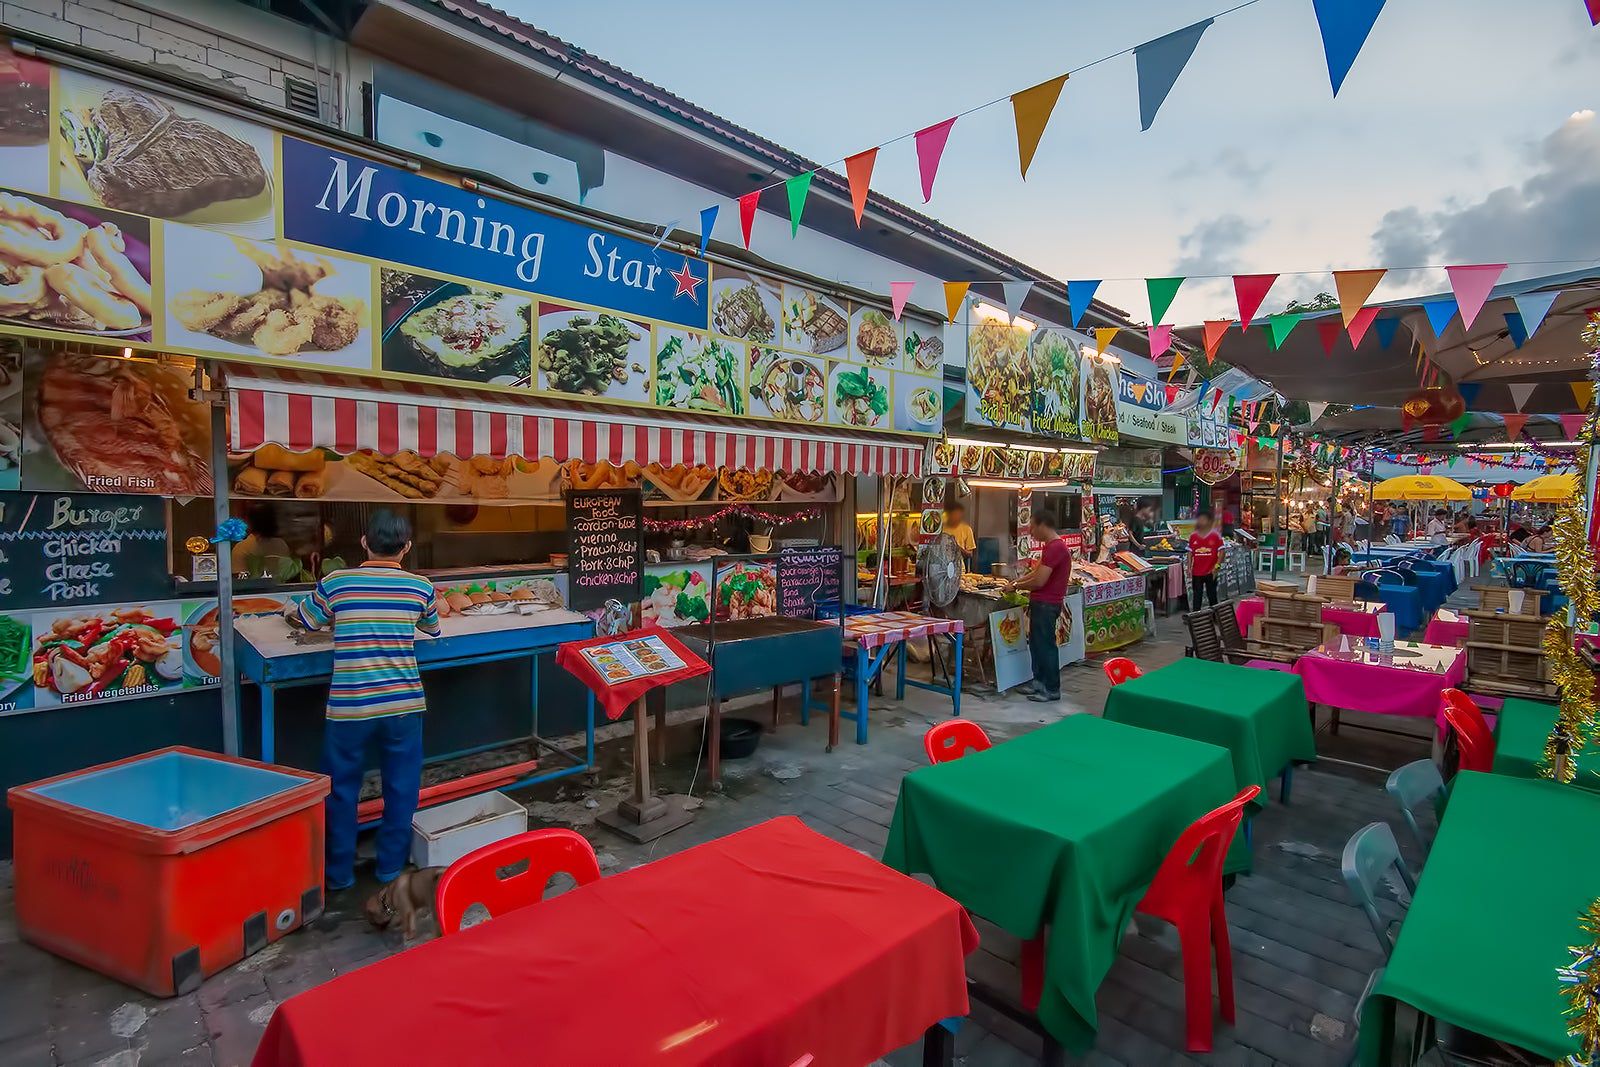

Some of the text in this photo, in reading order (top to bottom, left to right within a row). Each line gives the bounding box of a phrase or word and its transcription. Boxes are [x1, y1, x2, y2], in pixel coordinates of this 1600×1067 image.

[315, 156, 662, 292] Morning Star
[1002, 402, 1020, 425] Thai
[1032, 410, 1051, 431] Fried
[1132, 414, 1156, 431] Seafood
[1162, 421, 1177, 435] Steak
[1202, 455, 1220, 472] 80
[87, 475, 155, 488] Fried Fish
[573, 496, 622, 509] EUROPEAN
[47, 496, 143, 532] Burger
[43, 537, 122, 558] Chicken
[40, 581, 100, 601] Pork
[61, 682, 159, 704] Fried vegetables
